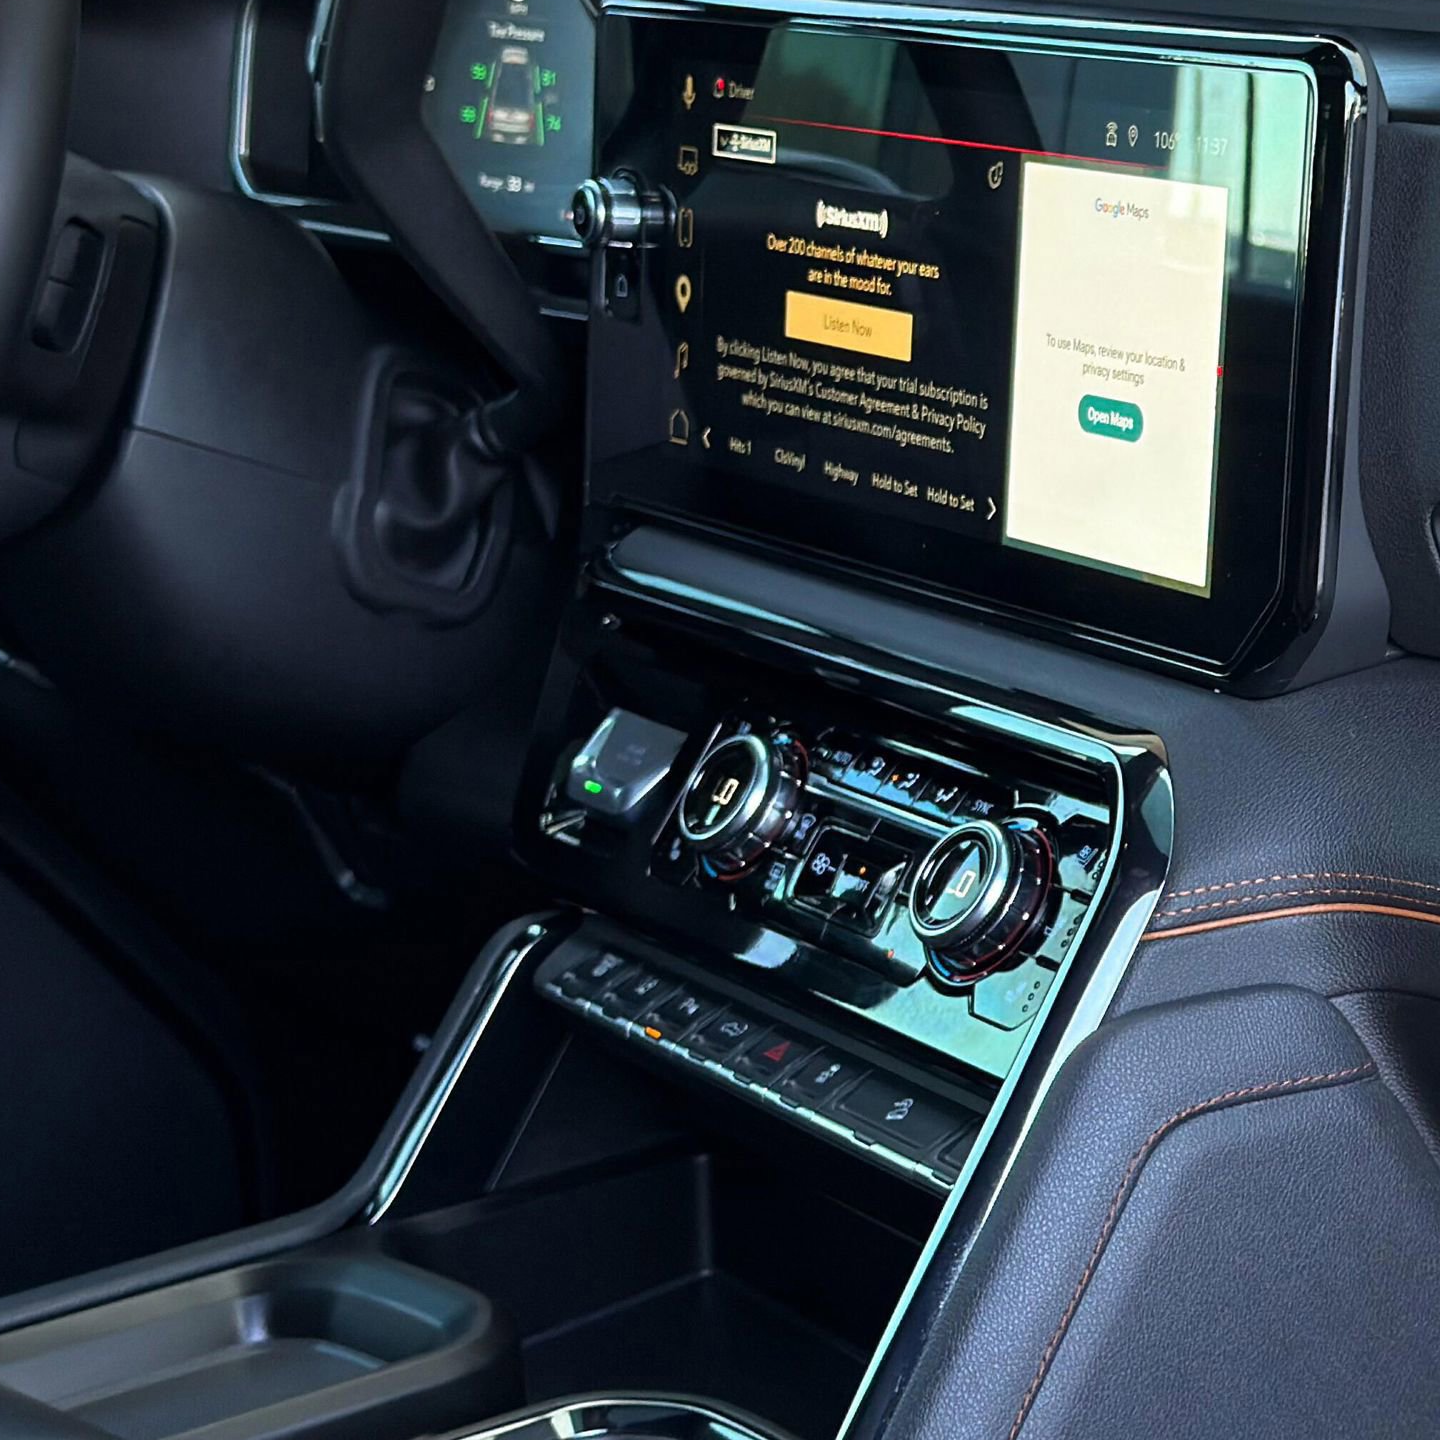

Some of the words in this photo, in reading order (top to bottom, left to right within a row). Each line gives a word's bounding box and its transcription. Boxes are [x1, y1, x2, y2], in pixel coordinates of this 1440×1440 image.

[728, 79, 756, 101] Driver
[1094, 197, 1125, 219] Google
[1126, 201, 1150, 222] Maps
[767, 232, 788, 252] Over
[788, 236, 806, 256] 200
[806, 240, 845, 262] channels
[845, 246, 856, 264] of
[856, 249, 897, 271] whatever
[896, 260, 918, 277] your
[919, 263, 940, 279] ears
[807, 268, 823, 283] are
[823, 268, 832, 285] in
[833, 269, 848, 288] the
[849, 275, 876, 293] mood
[876, 276, 892, 296] for.
[823, 314, 850, 332] Listen
[852, 321, 873, 338] Now
[1046, 332, 1056, 348] To
[1057, 337, 1071, 351] use
[1072, 338, 1097, 358] Maps,
[1098, 344, 1124, 361] review
[1125, 350, 1144, 365] your
[1145, 352, 1178, 370] location
[1179, 357, 1186, 372] &
[717, 334, 729, 357] By
[729, 339, 761, 365] clicking
[761, 345, 788, 365] Listen
[788, 352, 812, 373] Now,
[811, 360, 829, 378] you
[829, 364, 856, 383] agree
[856, 366, 876, 386] that
[876, 374, 898, 391] your
[898, 377, 918, 395] trial
[919, 380, 978, 408] subscription
[978, 392, 989, 411] is
[1082, 362, 1111, 381] privacy
[1111, 368, 1145, 387] settings
[717, 363, 757, 384] governed
[757, 367, 769, 391] by
[814, 381, 859, 406] Customer
[859, 392, 911, 419] Agreement
[911, 403, 920, 420] &
[920, 404, 956, 433] Privacy
[956, 413, 987, 440] Policy
[741, 390, 768, 409] which
[767, 400, 784, 416] you
[784, 403, 801, 417] can
[801, 404, 821, 422] view
[821, 410, 832, 424] at
[1087, 406, 1110, 425] Open
[1110, 411, 1134, 432] Maps
[823, 460, 860, 486] Highway
[871, 472, 893, 491] Hold
[893, 479, 903, 494] to
[903, 480, 919, 498] Set
[926, 486, 948, 505] Hold
[949, 493, 959, 508] to
[959, 494, 975, 513] Set
